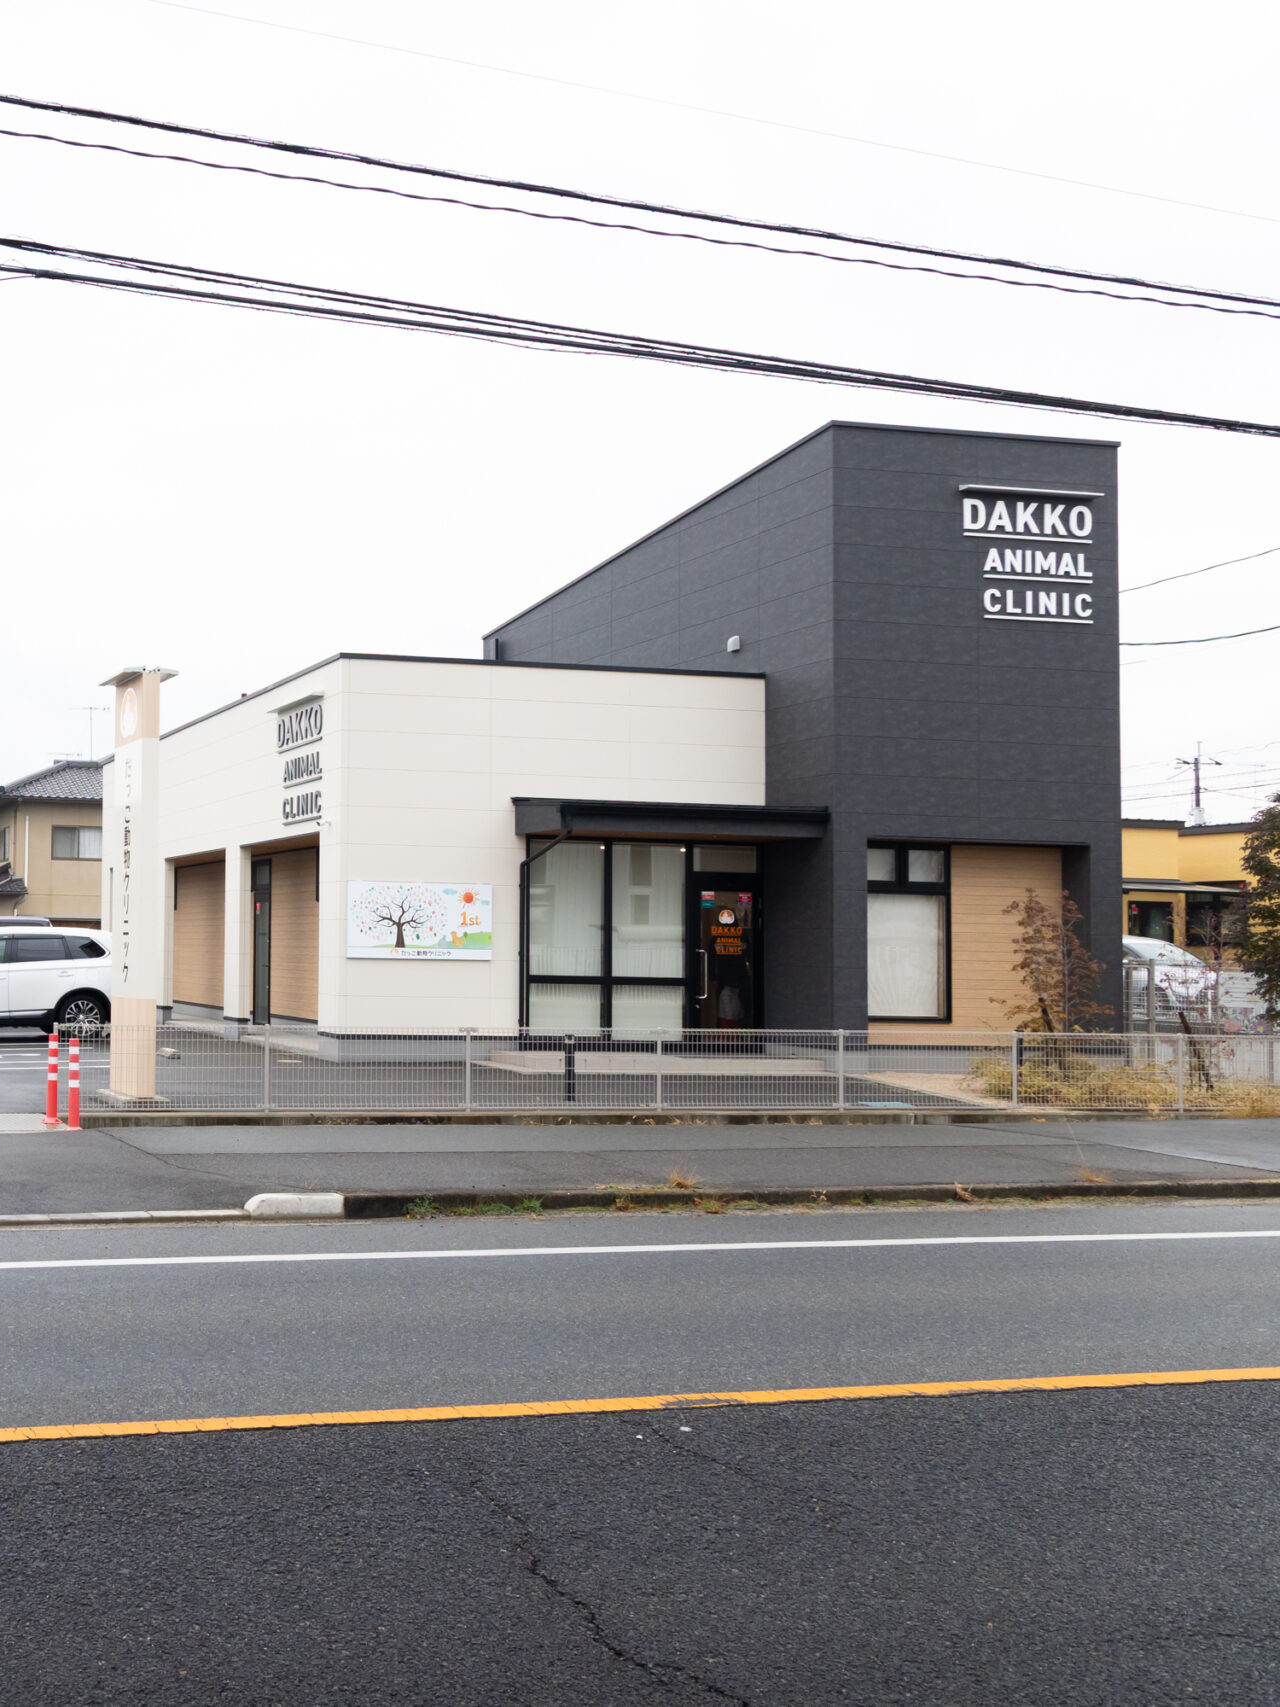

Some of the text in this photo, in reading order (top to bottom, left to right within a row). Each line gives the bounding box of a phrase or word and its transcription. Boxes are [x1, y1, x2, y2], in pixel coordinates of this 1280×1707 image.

[962, 498, 1093, 537] DAKKO
[983, 548, 1093, 577] ANIMAL
[983, 588, 1093, 617] CLINIC
[277, 704, 323, 748] DAKKO
[283, 751, 322, 783] ANIMAL
[282, 790, 322, 819] CLINIC
[460, 911, 480, 926] 1st
[711, 926, 742, 936] DAKKO
[716, 946, 742, 954] CLINIC
